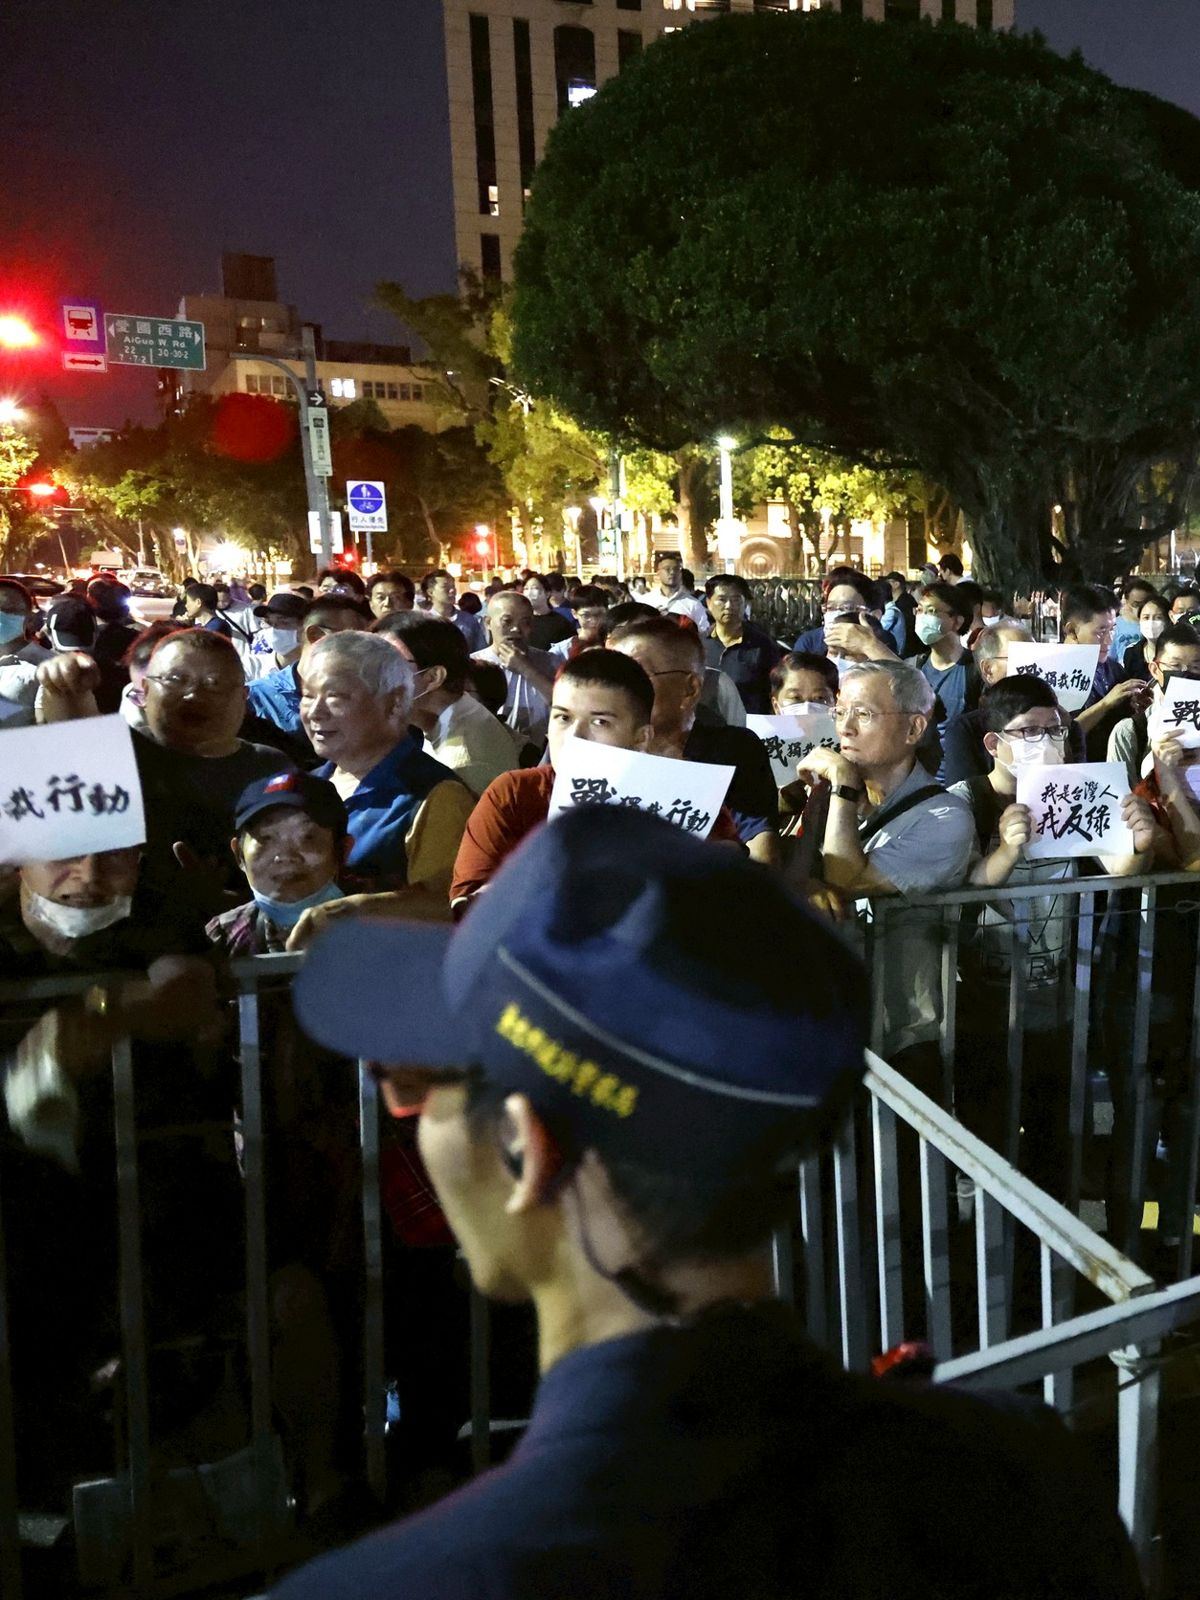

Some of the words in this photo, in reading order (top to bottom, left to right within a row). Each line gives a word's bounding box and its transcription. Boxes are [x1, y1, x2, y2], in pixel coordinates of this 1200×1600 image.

[115, 320, 193, 338] 愛國西路
[1041, 781, 1119, 804] 我是台灣人
[1036, 804, 1111, 842] 我反綠
